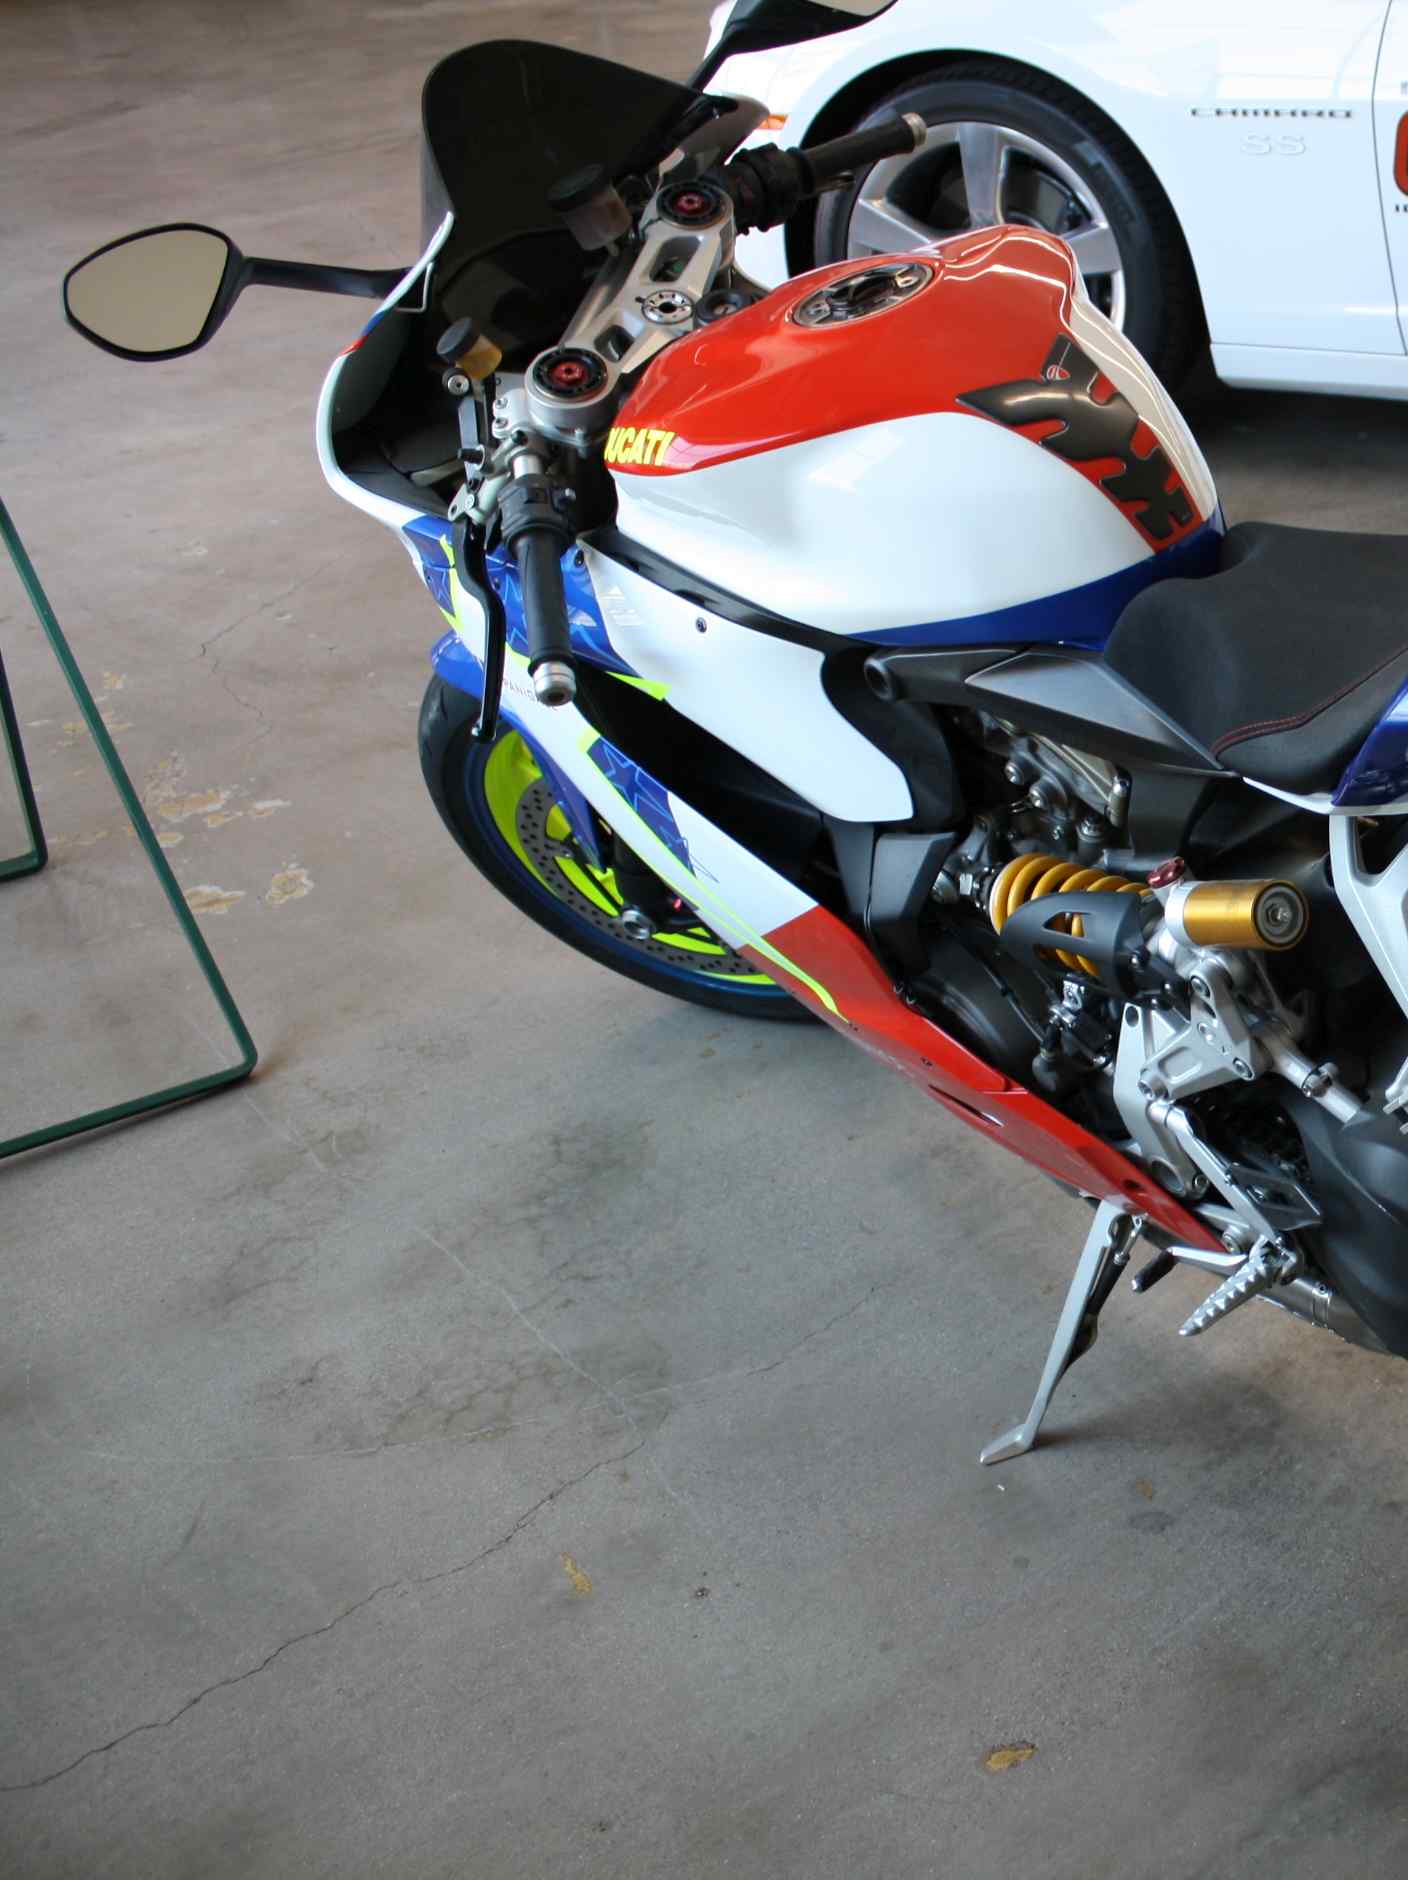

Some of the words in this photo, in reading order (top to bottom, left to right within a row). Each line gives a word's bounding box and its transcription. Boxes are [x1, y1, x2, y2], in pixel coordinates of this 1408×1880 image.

[1190, 107, 1353, 119] CAMARO
[1241, 133, 1306, 156] SS
[604, 427, 675, 466] UCATI
